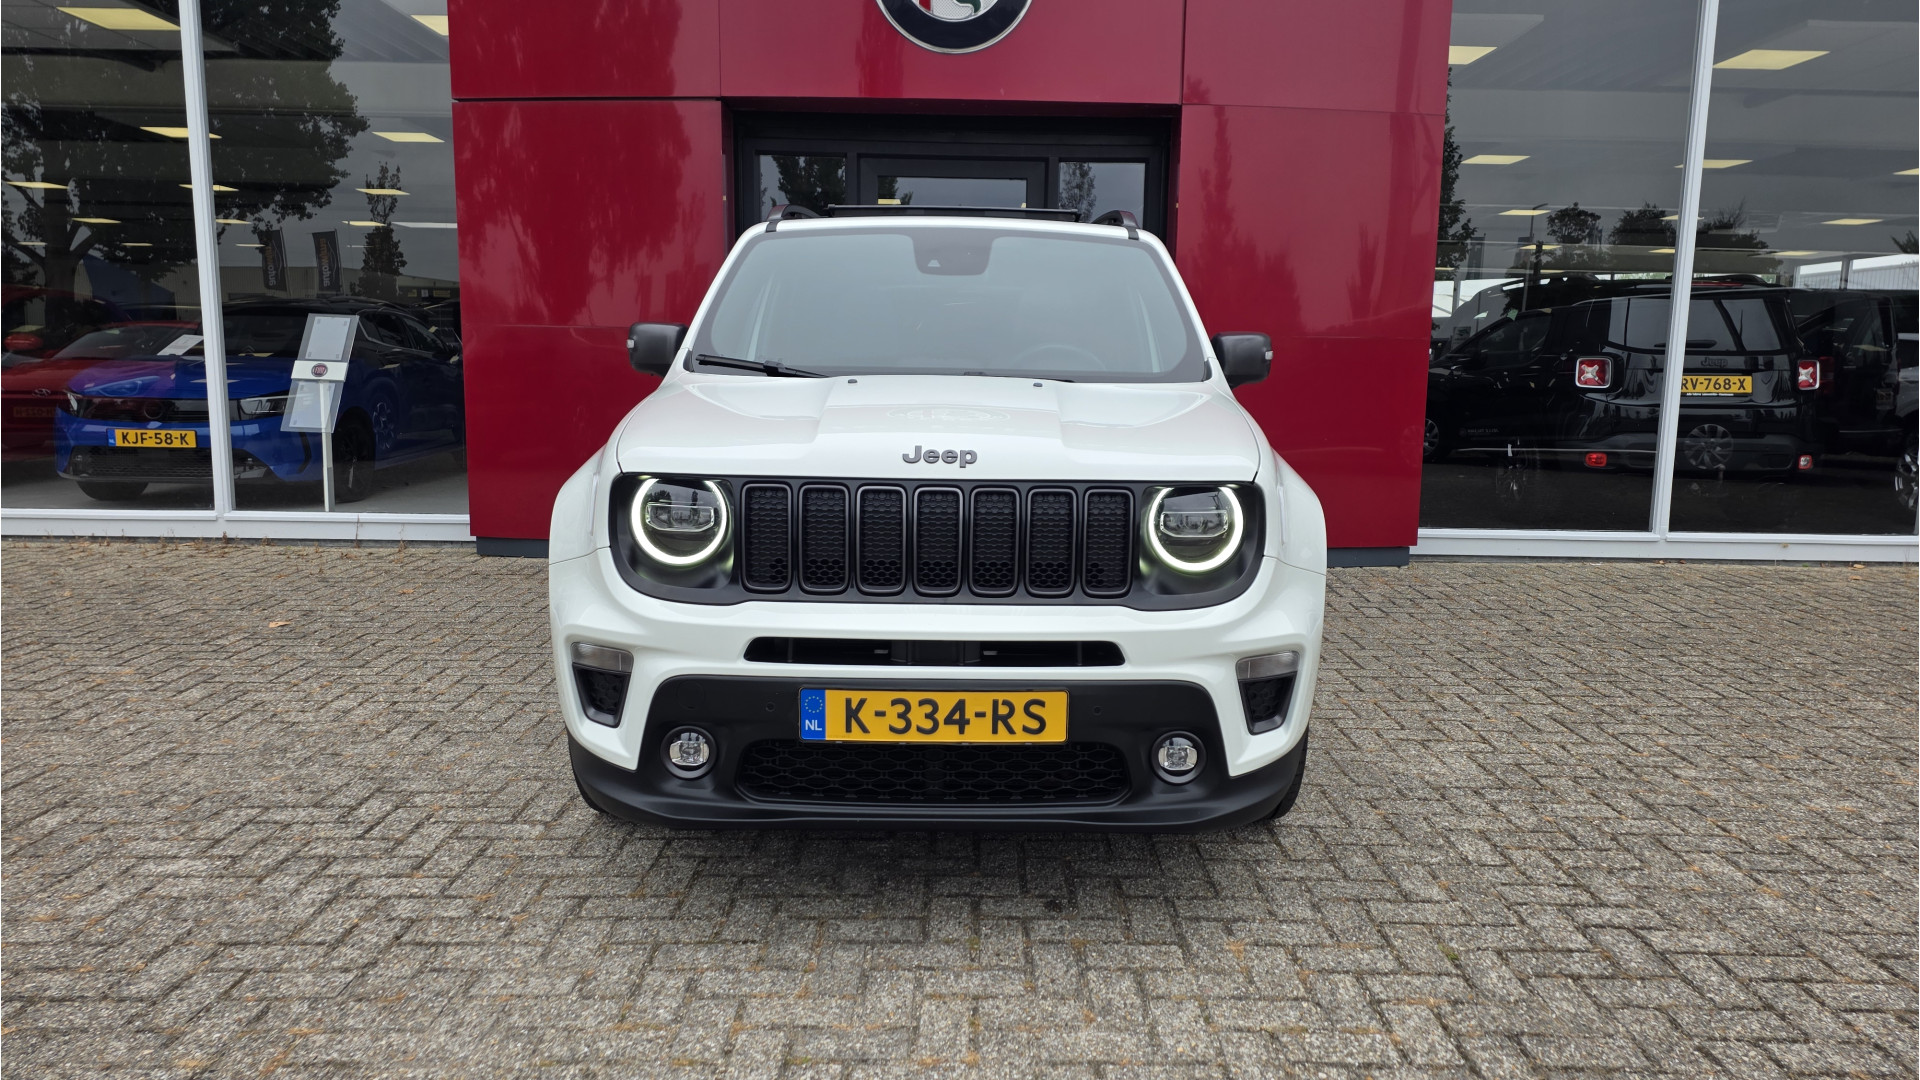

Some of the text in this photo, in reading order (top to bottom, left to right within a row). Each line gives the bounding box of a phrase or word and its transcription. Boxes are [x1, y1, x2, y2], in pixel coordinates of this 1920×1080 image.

[1701, 357, 1728, 367] Jeep
[1681, 378, 1746, 390] RV-768-X
[121, 431, 190, 445] KJF-58-K
[902, 445, 978, 468] Jeep
[845, 697, 1047, 735] K-334-RS
[805, 719, 822, 731] NL
